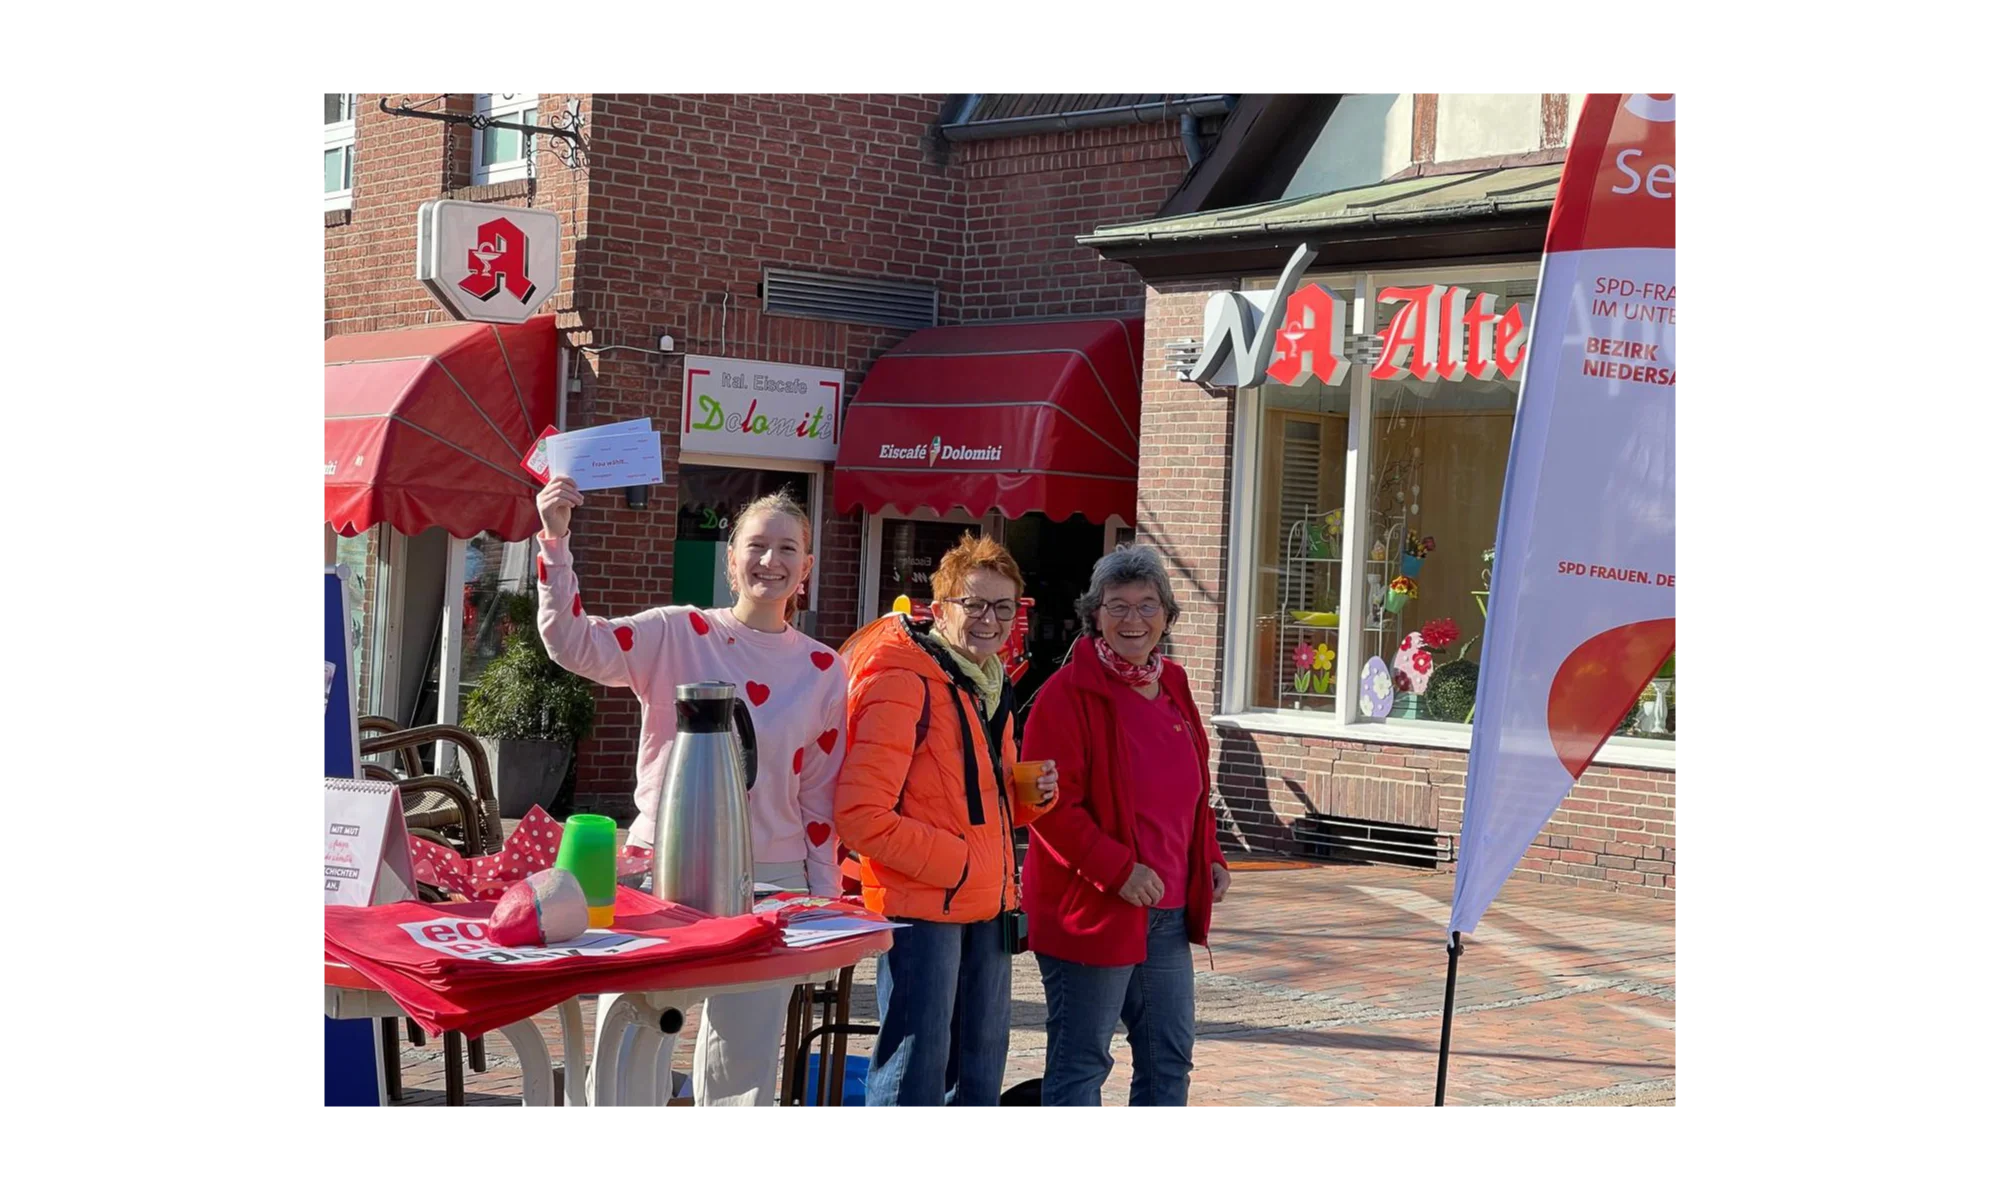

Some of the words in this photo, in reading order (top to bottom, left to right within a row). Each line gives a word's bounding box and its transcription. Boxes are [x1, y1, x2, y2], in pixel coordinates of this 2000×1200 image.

[1612, 148, 1677, 198] Se
[1595, 277, 1677, 301] SPD-FRA
[1592, 298, 1617, 317] IM
[1624, 302, 1677, 325] UNTE
[1368, 284, 1530, 382] Alte
[1586, 336, 1659, 361] BEZIRK
[721, 372, 748, 389] Ital.
[753, 374, 808, 394] Eiscafe
[692, 394, 833, 440] Dolomiti
[879, 443, 928, 460] Eiscafé
[941, 444, 1003, 461] Dolomiti
[699, 507, 733, 529] Do
[1558, 561, 1587, 576] SPD
[1590, 565, 1652, 585] FRAUEN.
[1656, 573, 1677, 587] DE
[331, 825, 343, 834] MIT
[344, 826, 359, 836] MUT
